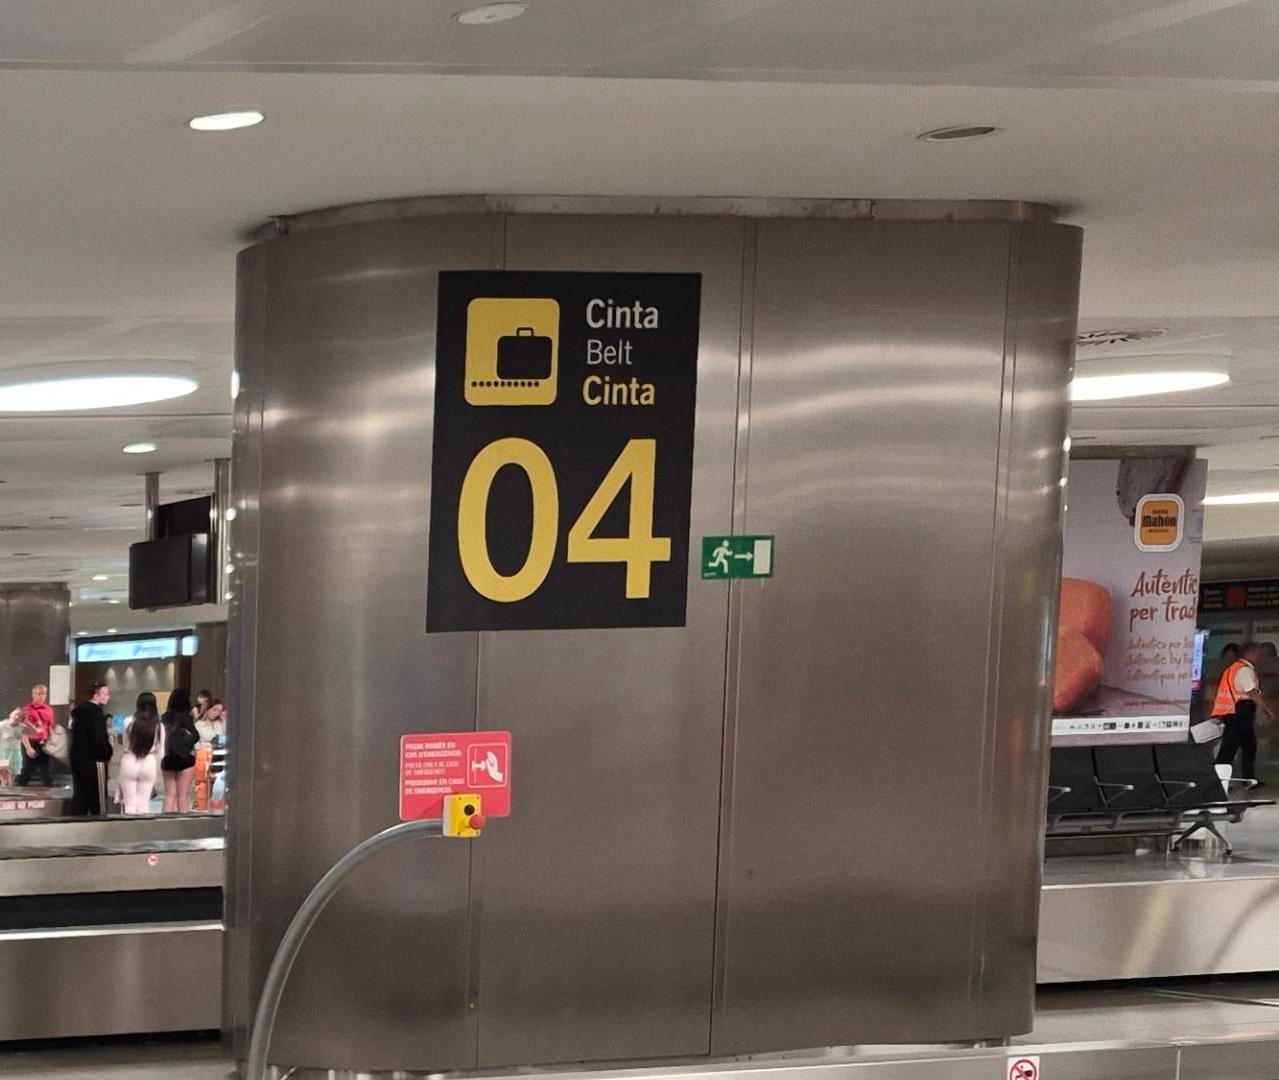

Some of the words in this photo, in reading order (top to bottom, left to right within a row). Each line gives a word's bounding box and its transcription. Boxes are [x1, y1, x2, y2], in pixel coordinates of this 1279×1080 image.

[586, 299, 659, 329] Cinta
[587, 339, 633, 366] Belt
[583, 376, 656, 405] Cinta
[457, 437, 672, 603] 04
[1129, 606, 1159, 633] per
[1162, 595, 1197, 622] trad
